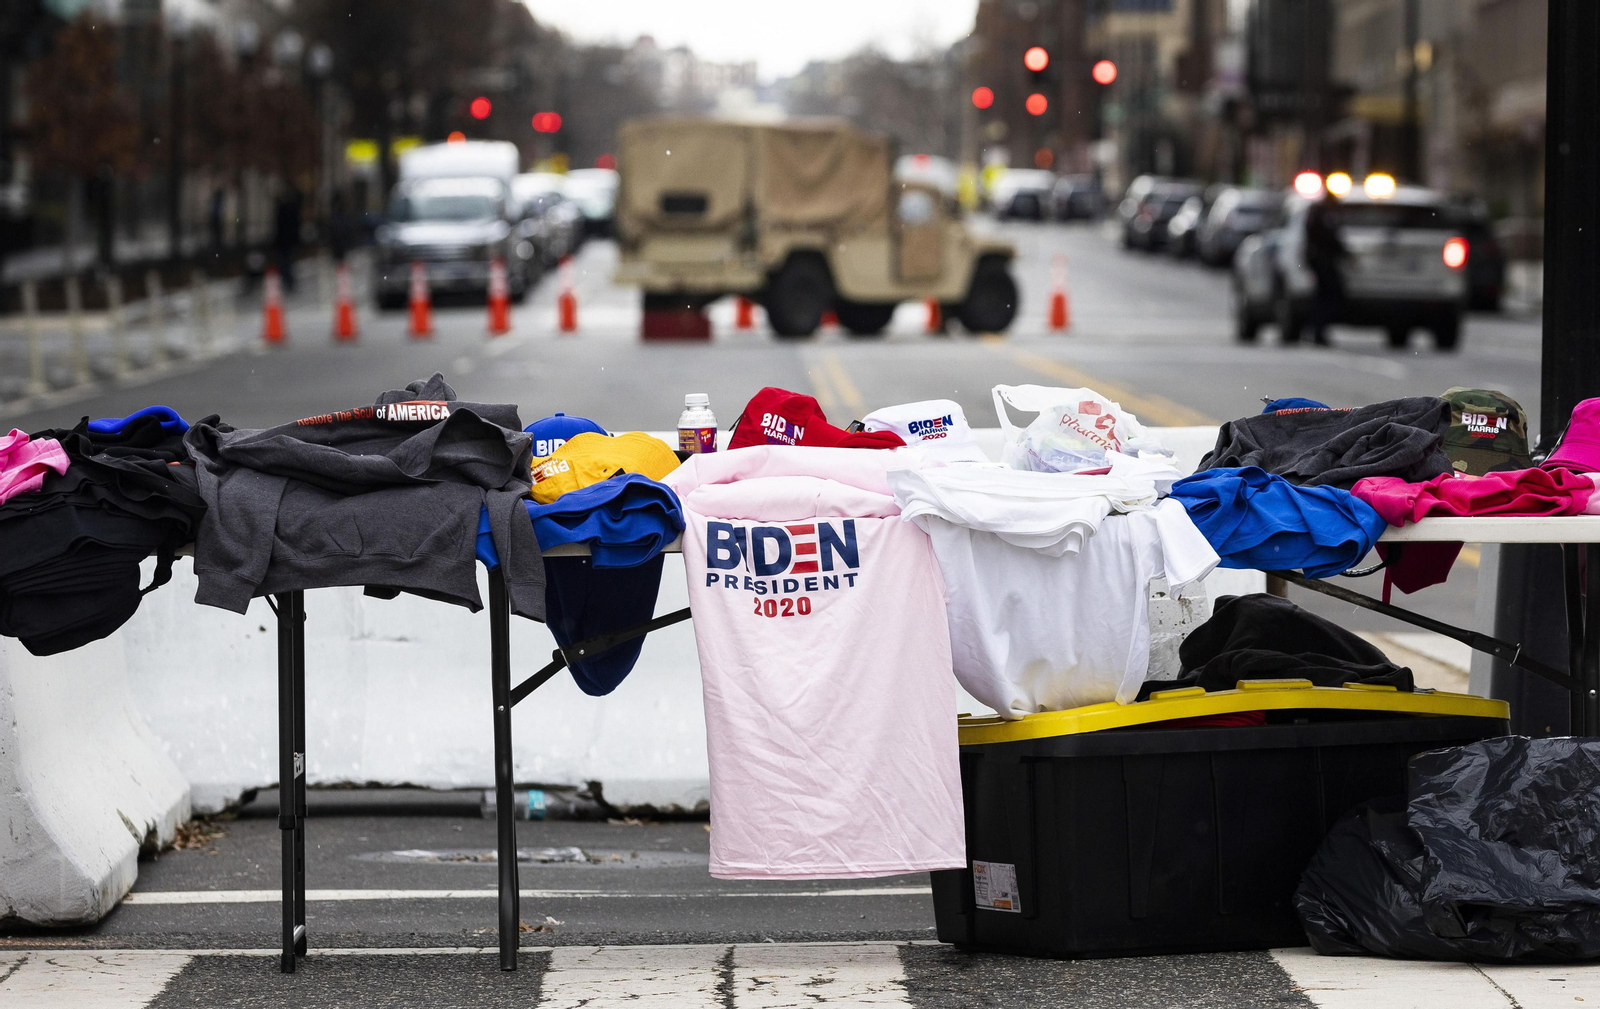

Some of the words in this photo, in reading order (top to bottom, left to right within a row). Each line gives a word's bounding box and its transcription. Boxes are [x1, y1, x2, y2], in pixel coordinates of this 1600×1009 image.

[334, 411, 352, 423] The
[353, 406, 374, 420] Soul
[376, 405, 387, 419] of
[387, 403, 450, 421] AMERICA
[1461, 412, 1507, 430] BIDEN
[760, 412, 805, 440] BIDEN
[908, 414, 953, 434] BIDEN
[919, 427, 948, 437] HARRIS
[1467, 425, 1499, 433] HARRIS
[763, 427, 796, 446] HARRIS
[922, 432, 947, 441] 2020
[536, 439, 567, 456] BID
[706, 519, 860, 577] BIDEN
[706, 572, 859, 595] PRESIDENT
[753, 596, 812, 618] 2020
